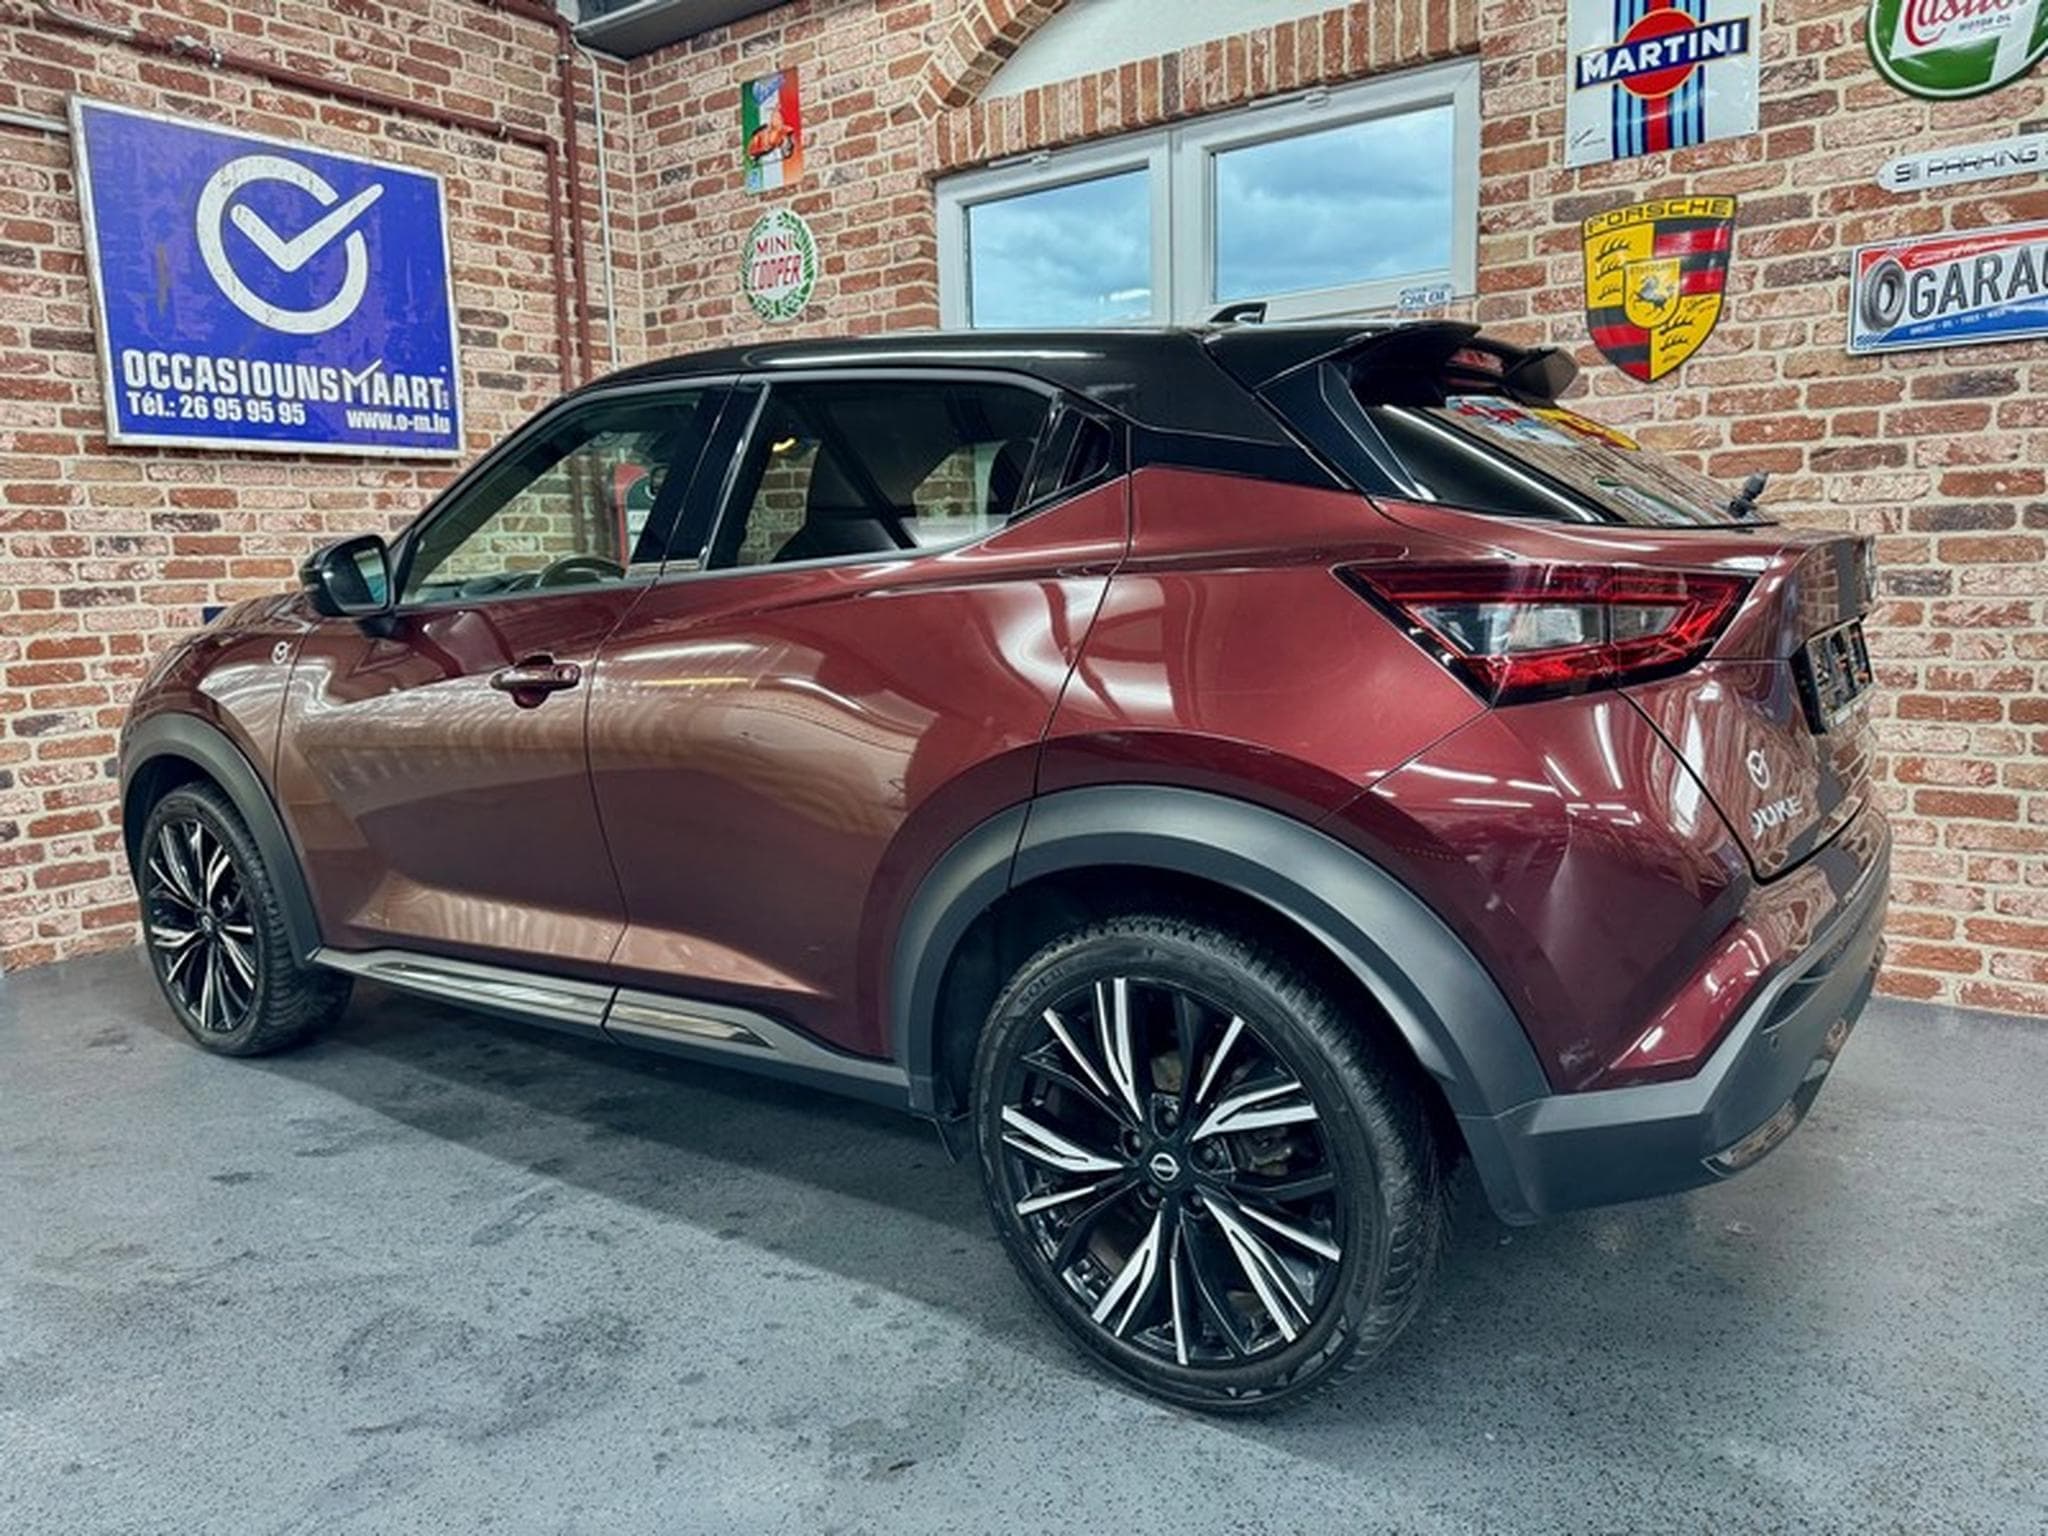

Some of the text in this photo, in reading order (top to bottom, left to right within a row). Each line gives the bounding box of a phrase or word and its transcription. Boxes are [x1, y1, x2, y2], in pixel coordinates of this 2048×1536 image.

[1996, 14, 2011, 24] OIL
[1582, 23, 1741, 83] MARTINI
[1927, 143, 2039, 177] PARKING
[1587, 199, 1730, 233] PORSCHE
[756, 233, 793, 255] MINI
[751, 254, 801, 291] COOPER
[1909, 246, 2048, 319] GARA
[126, 391, 306, 426] Tél.: 26 95 95 95
[346, 410, 450, 434] www.o-m.lu
[1751, 797, 1804, 840] JUKE
